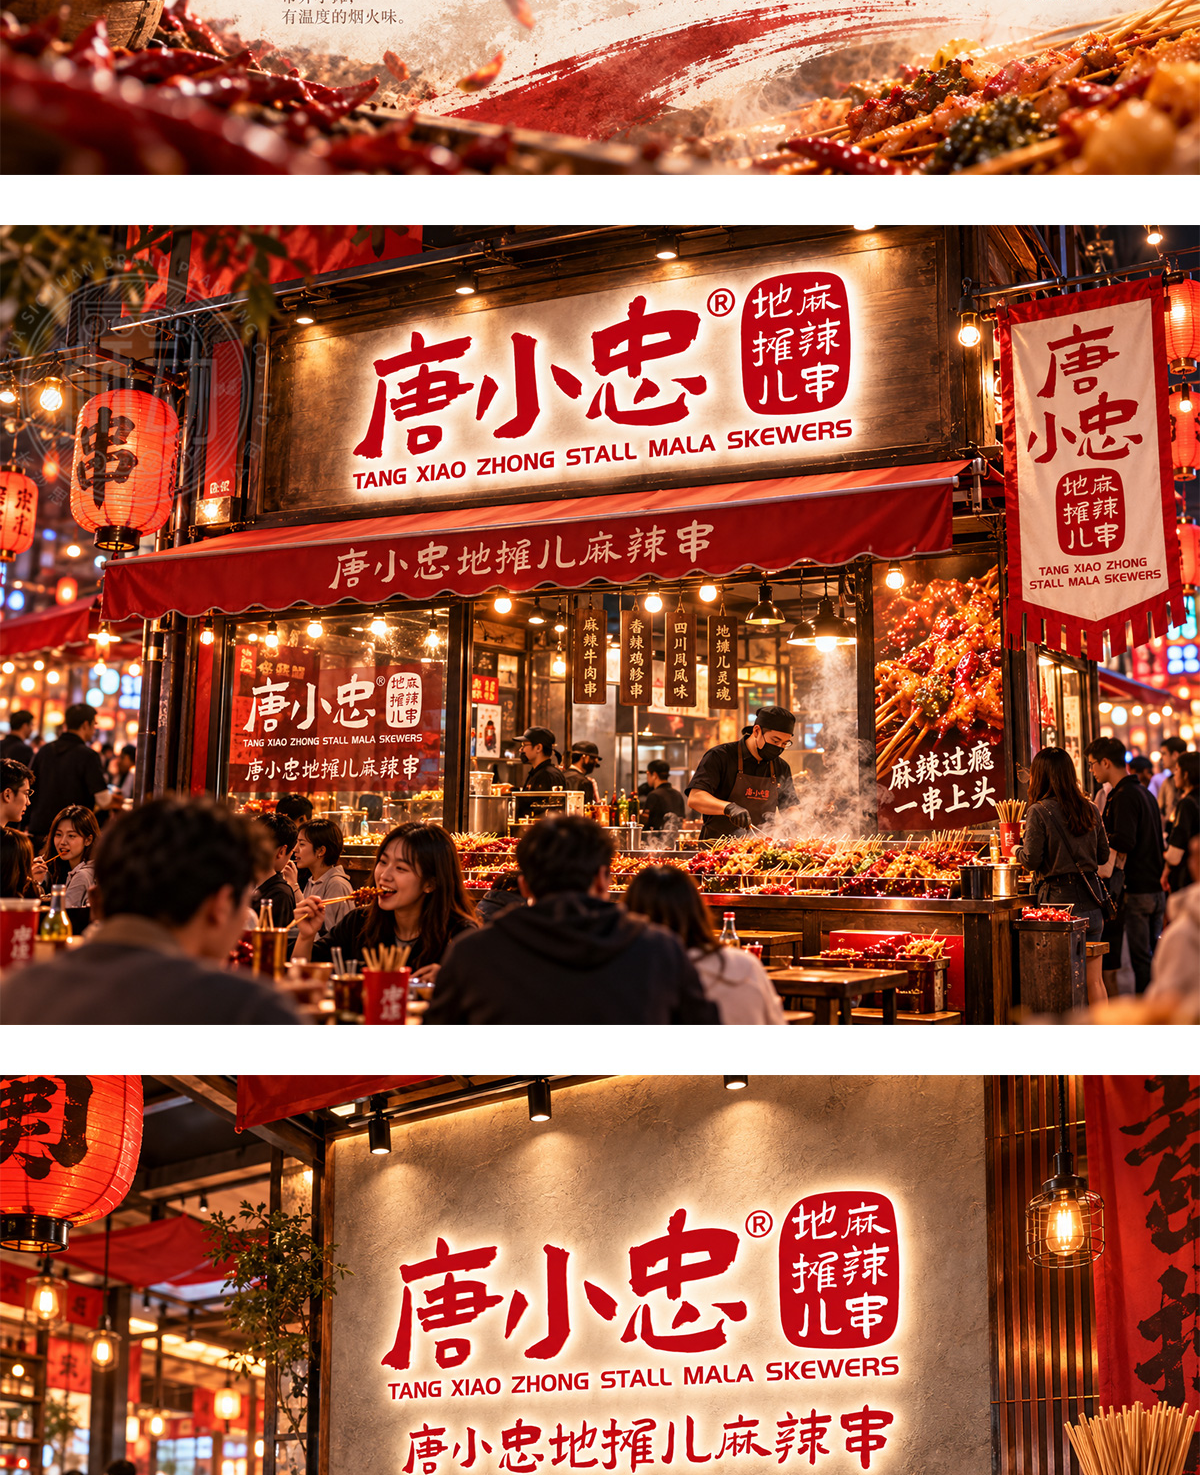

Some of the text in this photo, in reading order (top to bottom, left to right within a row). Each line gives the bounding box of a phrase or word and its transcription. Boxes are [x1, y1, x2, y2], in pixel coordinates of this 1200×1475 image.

[282, 9, 403, 24] 有温度的烟火味。
[353, 295, 707, 459] 唐小忠
[752, 281, 797, 404] 地摊儿
[797, 281, 842, 405] 麻辣串
[77, 406, 138, 510] 串
[353, 419, 852, 489] TANG XIAO ZHONG STALL MALA SKEWERS
[1063, 474, 1092, 550] 地摊儿
[1090, 474, 1119, 550] 麻辣串
[328, 519, 714, 591] 唐小忠地摊儿麻辣串
[1030, 569, 1161, 589] STALL MALA SKEWERS
[1039, 558, 1147, 577] TANG XIAO ZHONG
[583, 617, 599, 697] 麻辣牛肉串
[243, 673, 376, 732] 唐小忠
[243, 732, 422, 747] TANG XIAO ZHONG STALL MALA SKEWERS
[245, 755, 419, 781] 唐小忠地摊儿麻辣串
[888, 739, 997, 792] 麻辣过瘾
[894, 775, 997, 821] 一串上头
[379, 1208, 748, 1370] 唐小忠
[792, 1200, 841, 1339] 地摊儿
[841, 1202, 891, 1341] 麻辣串
[388, 1356, 899, 1399] TANG XIAO ZHONG STALL MALA SKEWERS
[402, 1405, 895, 1475] 唐小忠地摊儿麻辣串
